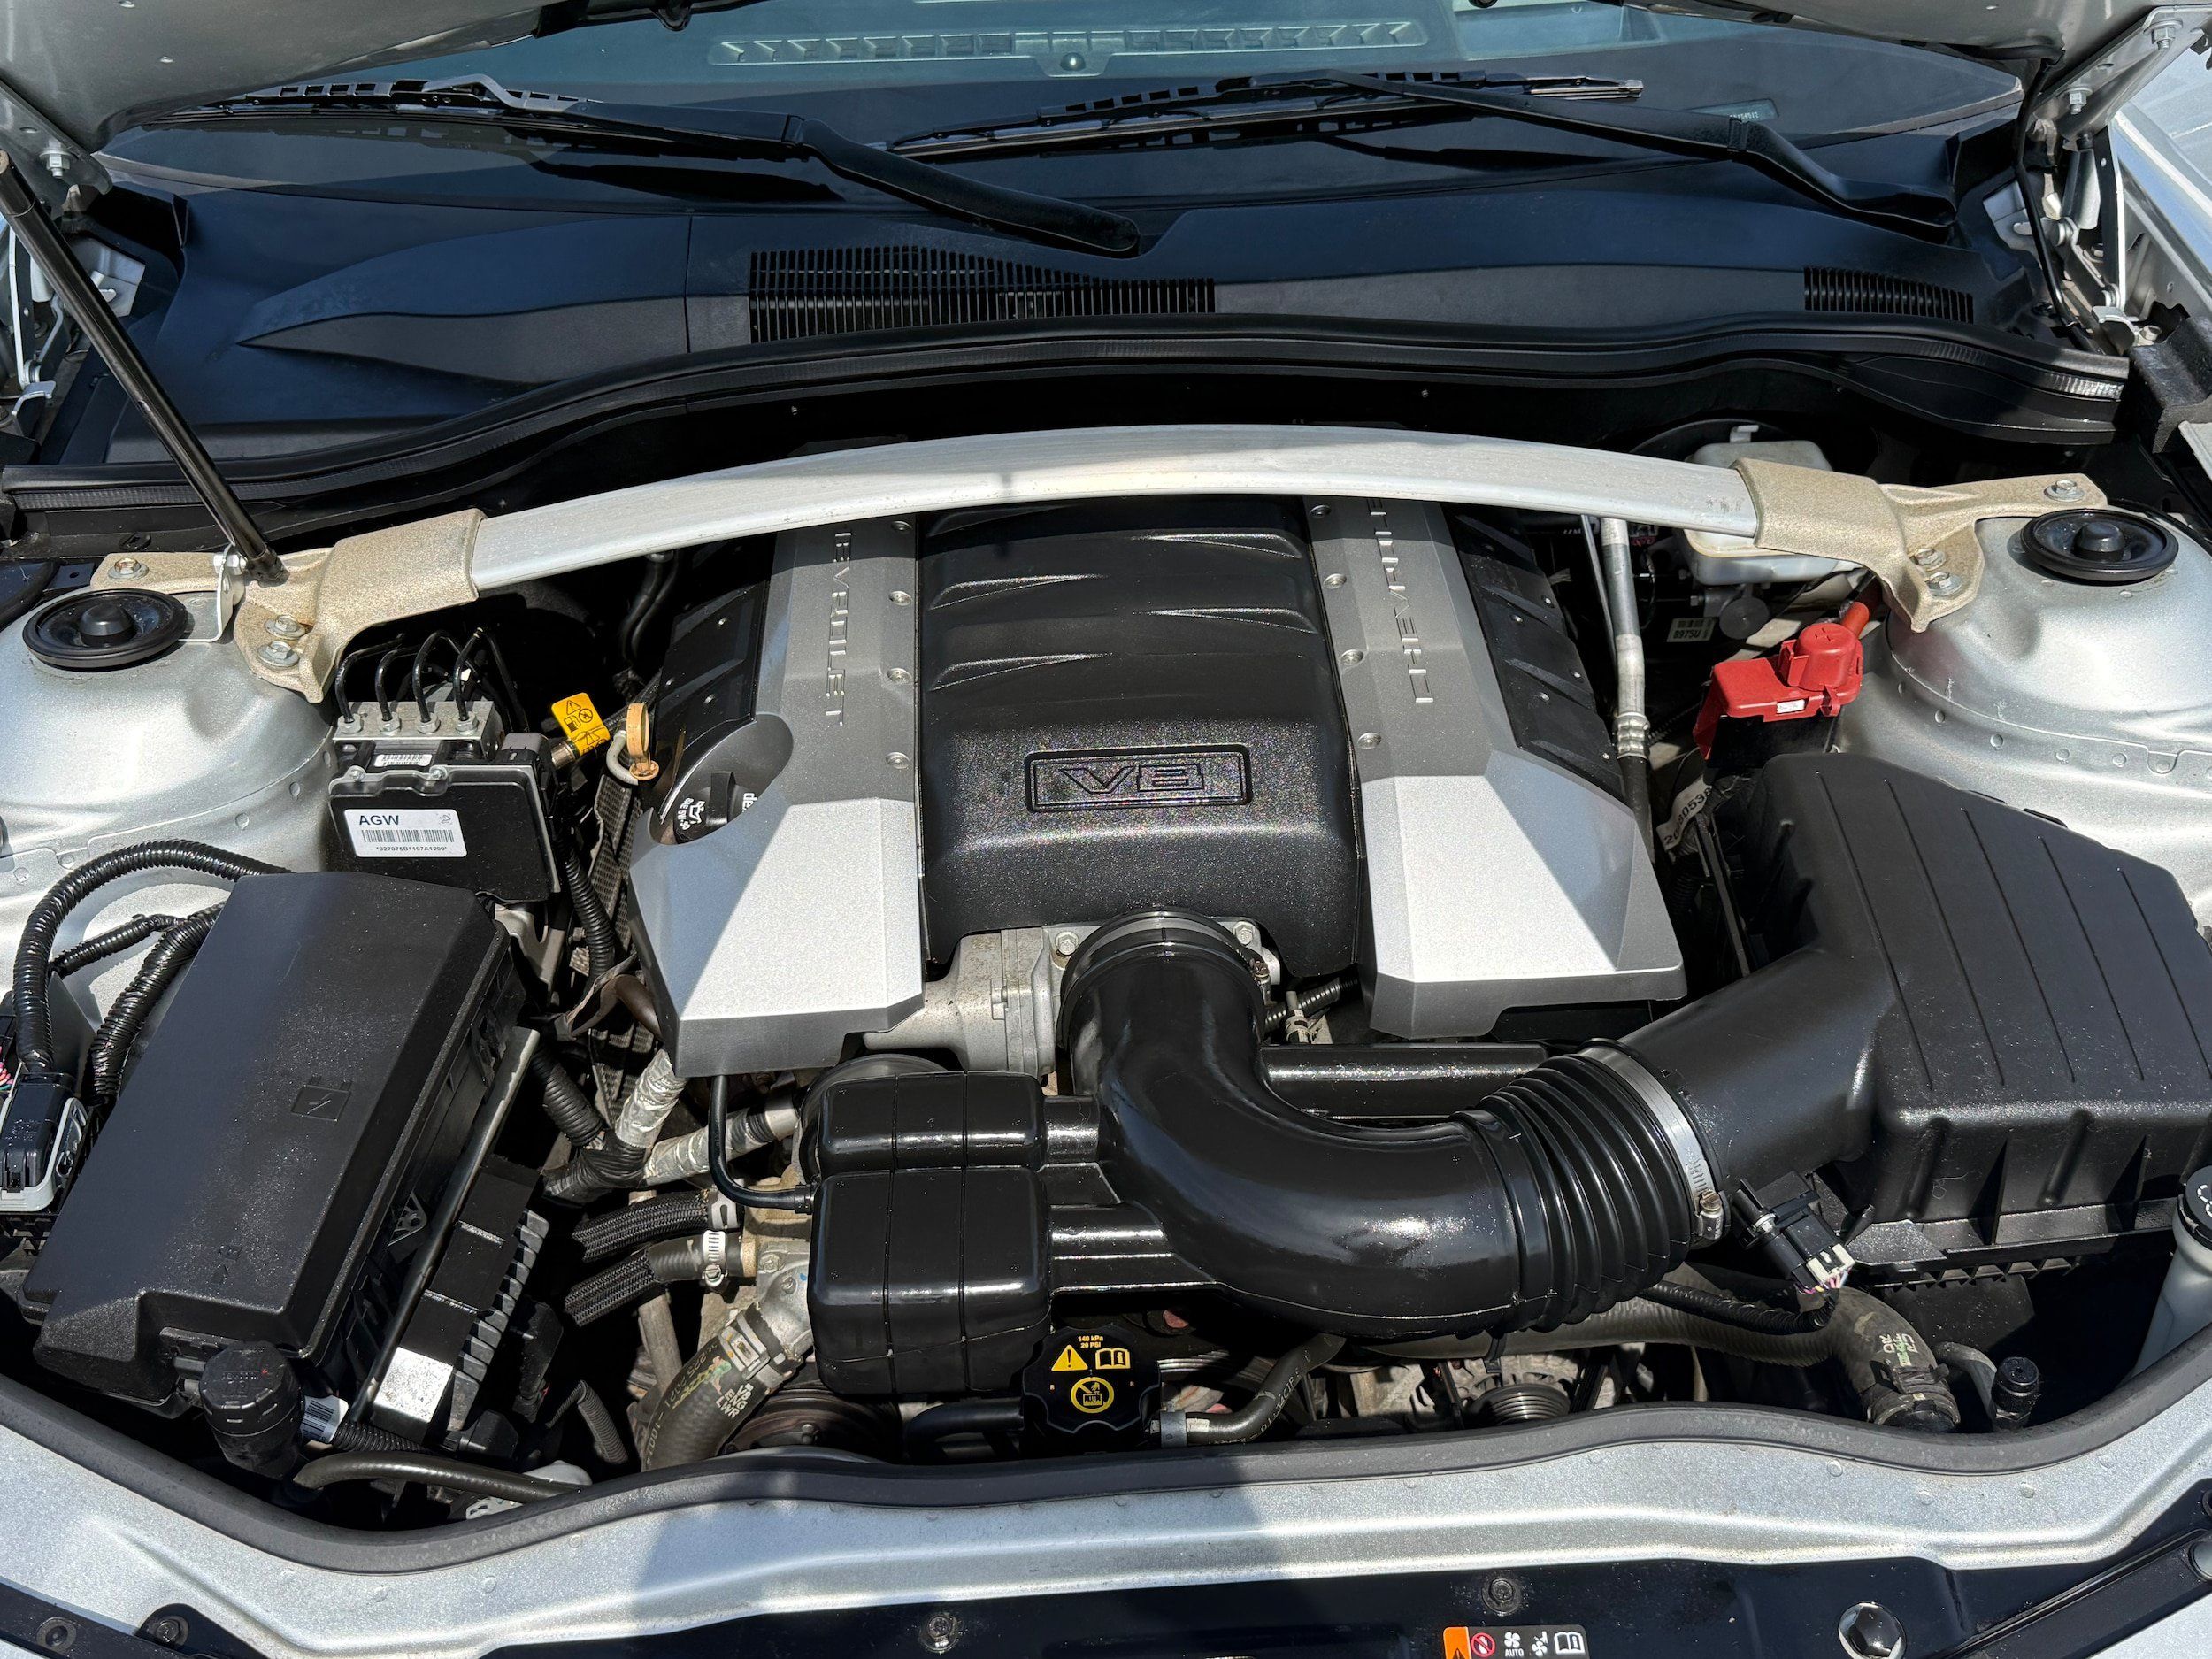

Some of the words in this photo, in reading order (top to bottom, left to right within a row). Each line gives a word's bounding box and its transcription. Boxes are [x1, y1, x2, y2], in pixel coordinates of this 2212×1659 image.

[1059, 763, 1204, 795] V8
[679, 797, 694, 810] SAE
[742, 792, 757, 813] de
[359, 815, 399, 826] AGW
[677, 810, 691, 830] 5W-30
[724, 1388, 749, 1410] ENG
[736, 1384, 752, 1402] V8
[715, 1394, 740, 1418] LWR
[1504, 1648, 1525, 1657] AUTO
